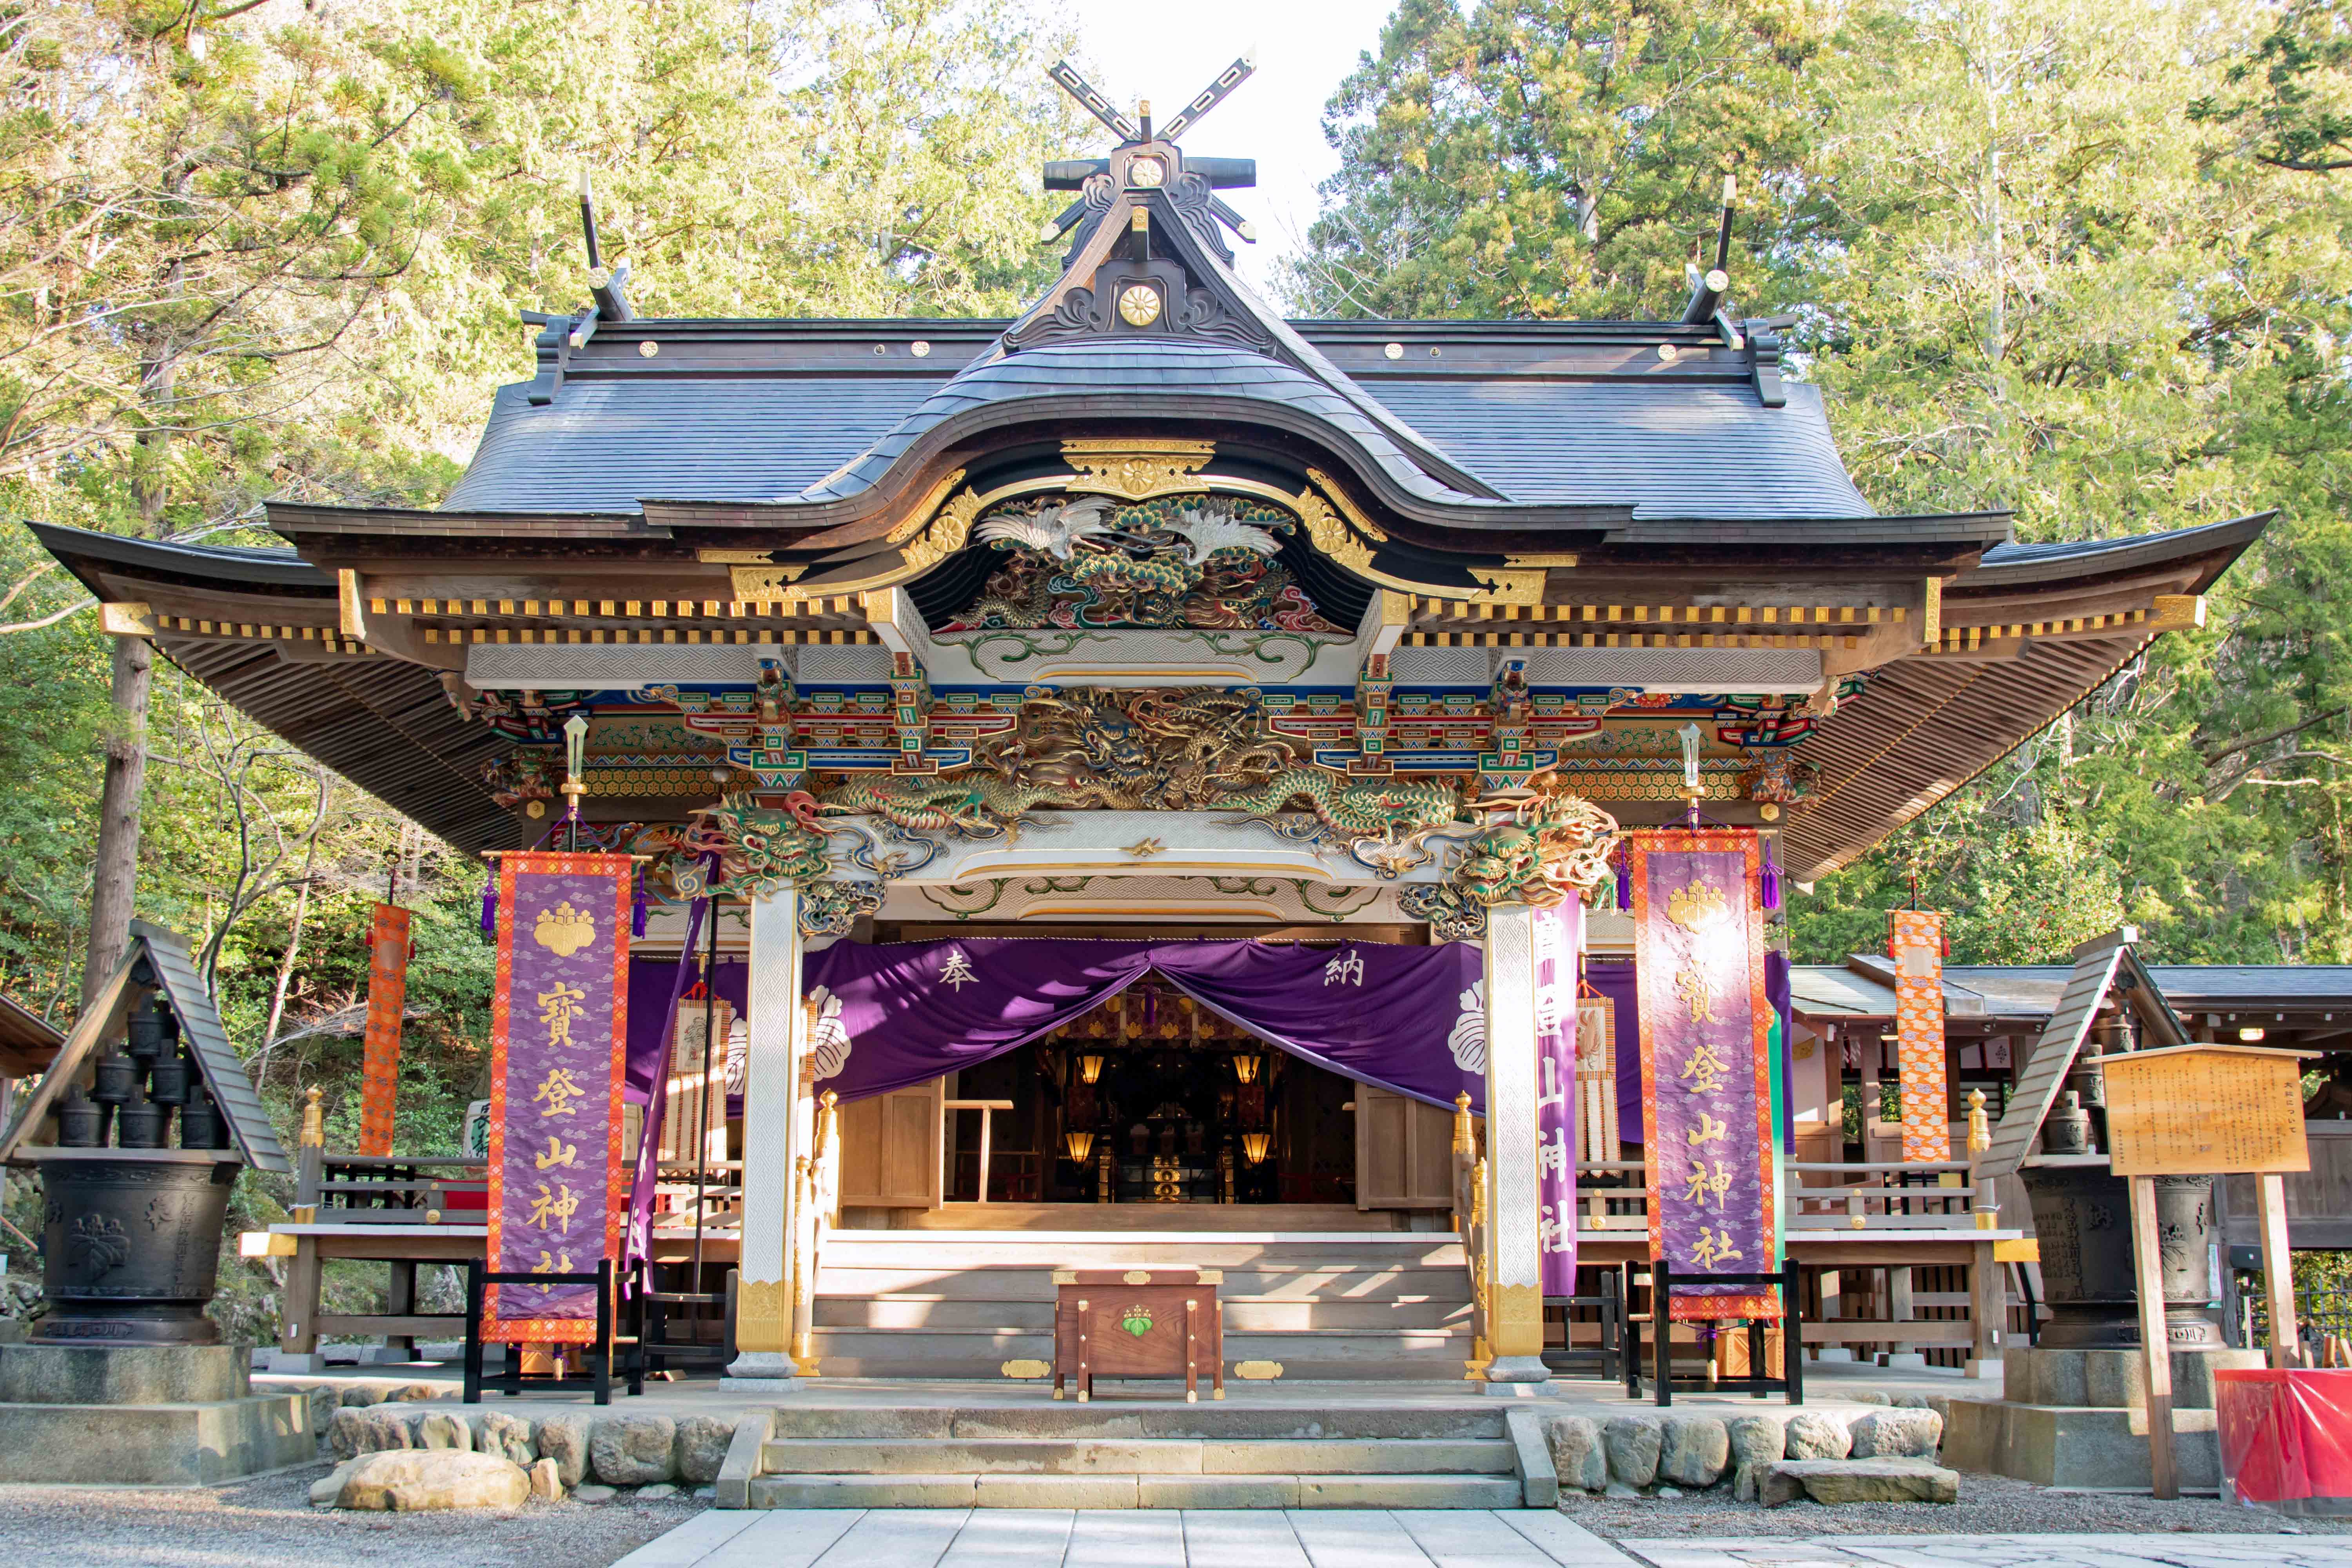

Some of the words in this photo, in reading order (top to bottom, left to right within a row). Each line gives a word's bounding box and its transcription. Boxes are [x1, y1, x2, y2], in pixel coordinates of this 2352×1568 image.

[939, 950, 980, 993] 奉
[1324, 950, 1364, 987] 納
[526, 982, 586, 1293] 寶登山神社
